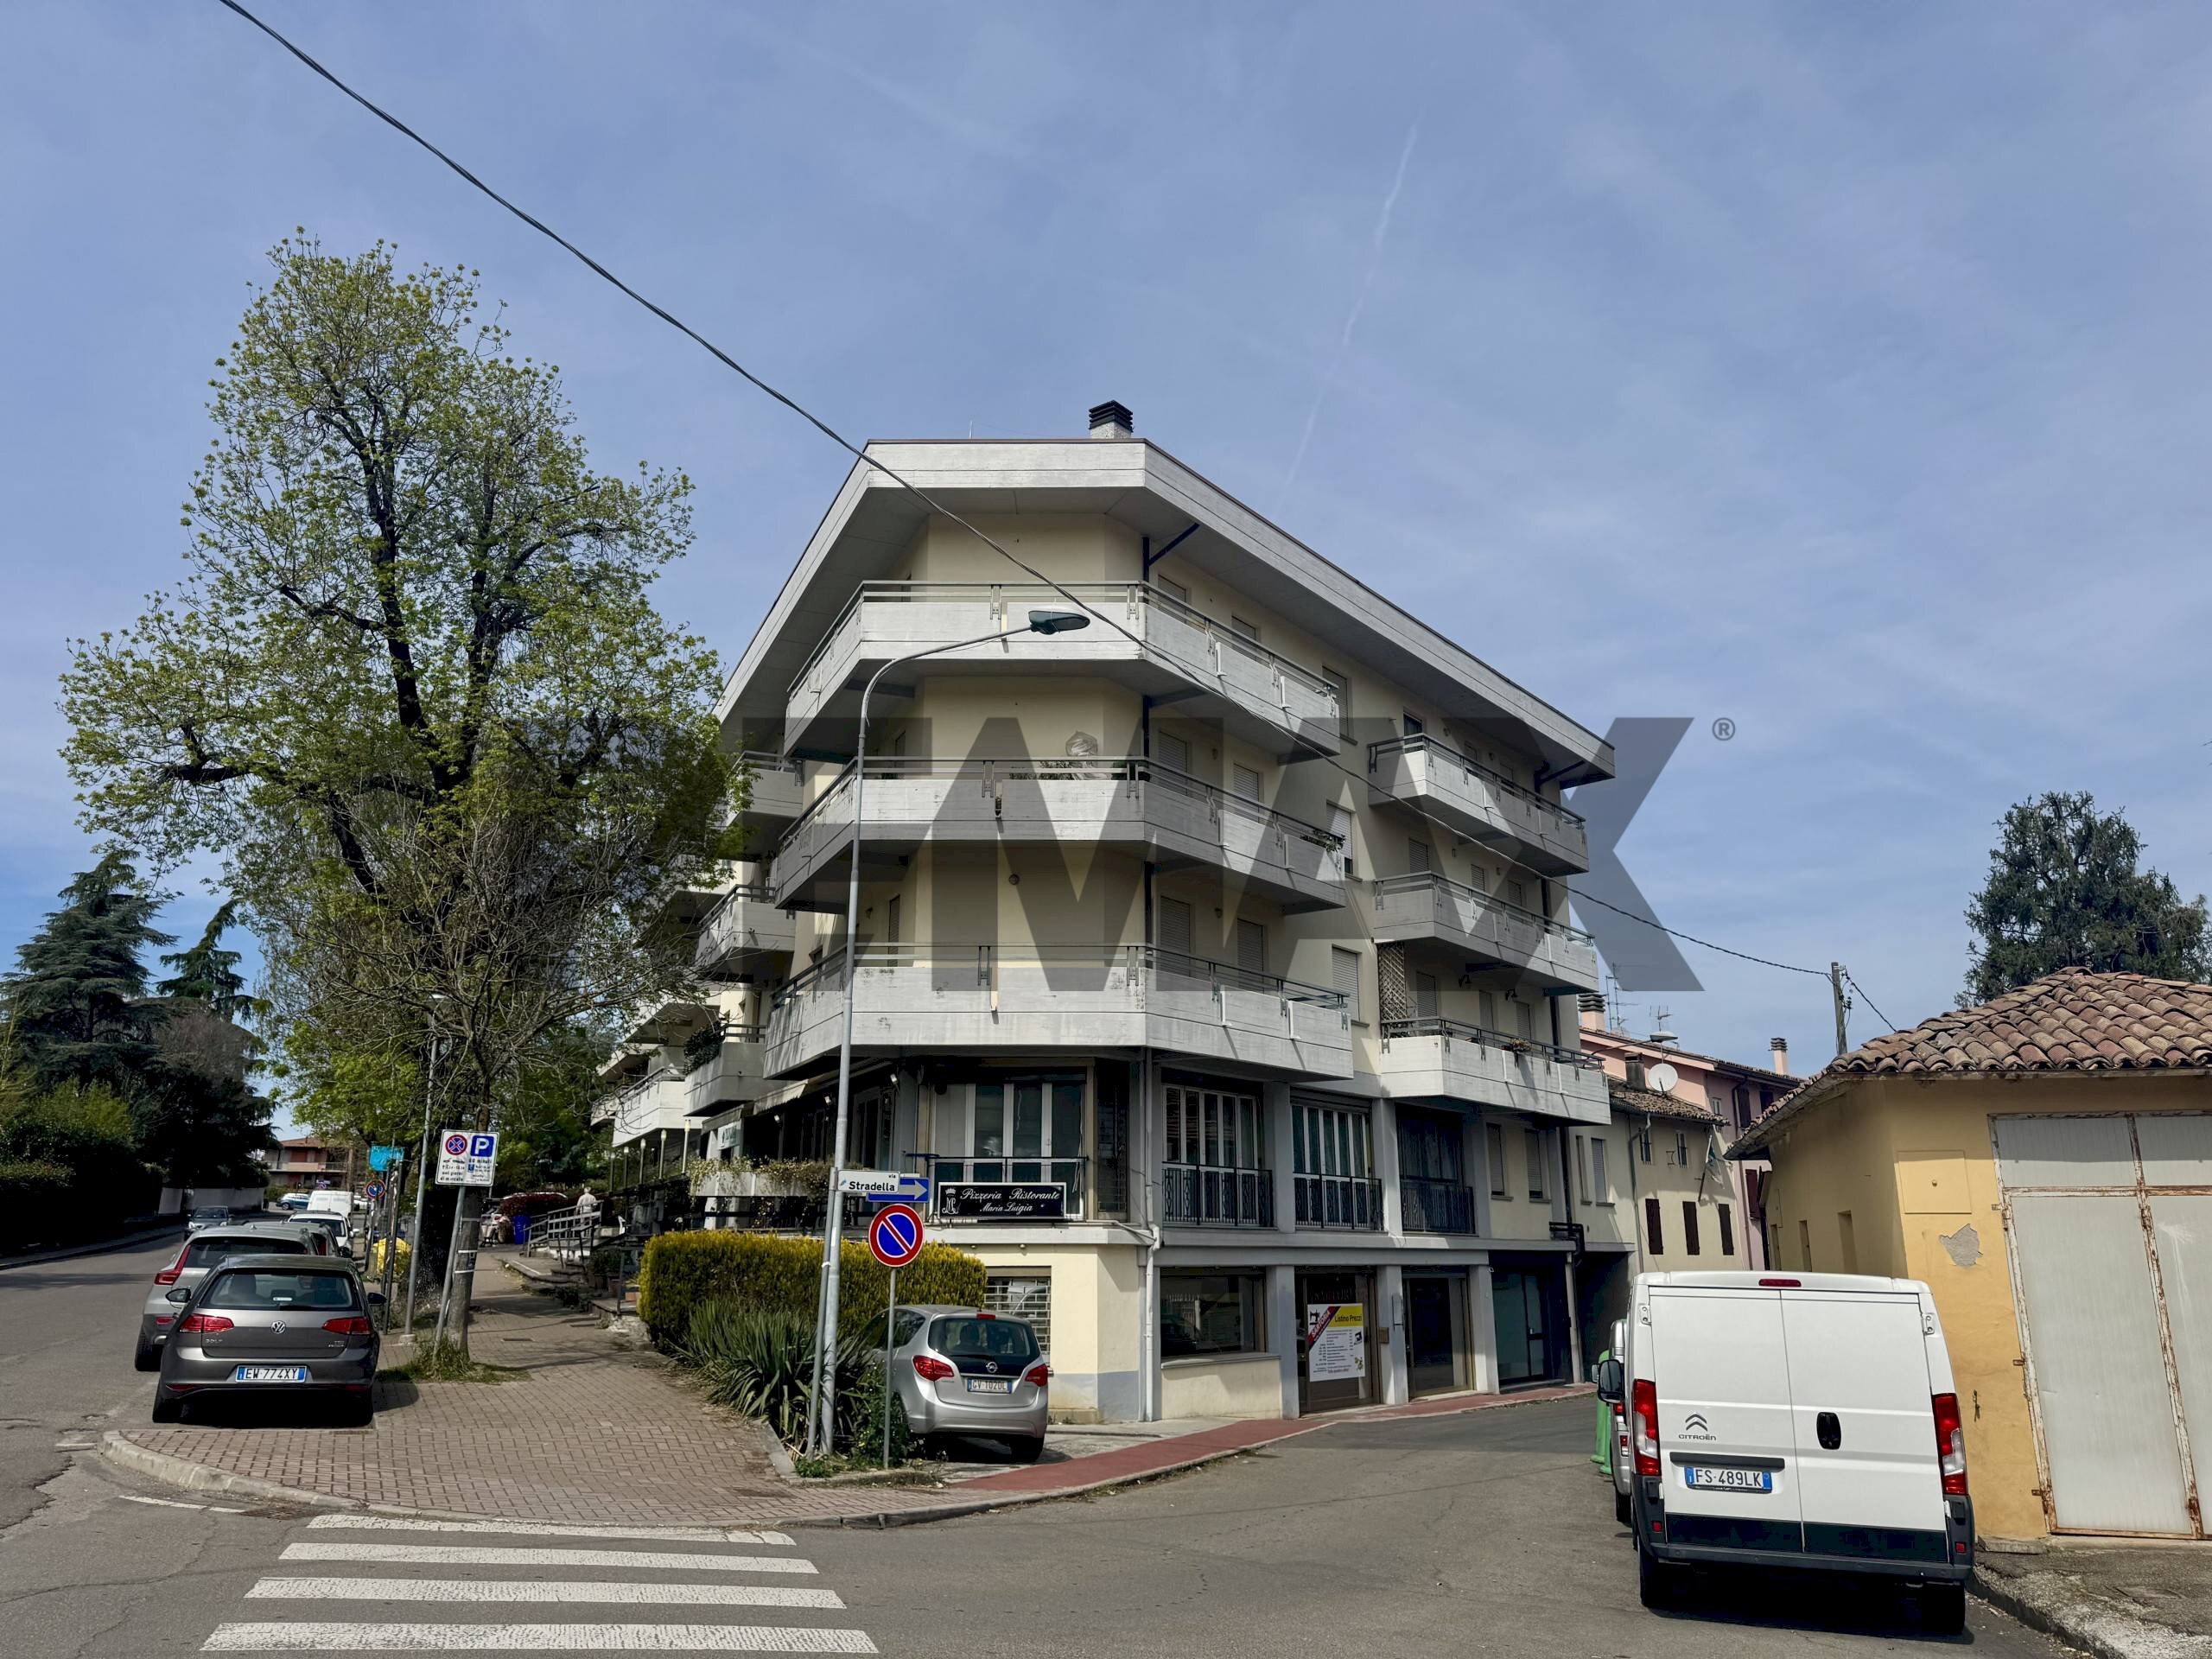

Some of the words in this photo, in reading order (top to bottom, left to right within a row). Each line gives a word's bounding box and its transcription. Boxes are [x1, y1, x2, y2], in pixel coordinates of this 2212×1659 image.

[849, 1180, 895, 1192] Stradella
[960, 1187, 1002, 1203] Pizzeria
[1009, 1187, 1061, 1200] Ristorante
[979, 1202, 1003, 1212] Maria
[1004, 1201, 1033, 1215] Luigia
[1334, 1314, 1349, 1323] Listino
[1718, 1470, 1762, 1487] 489LK
